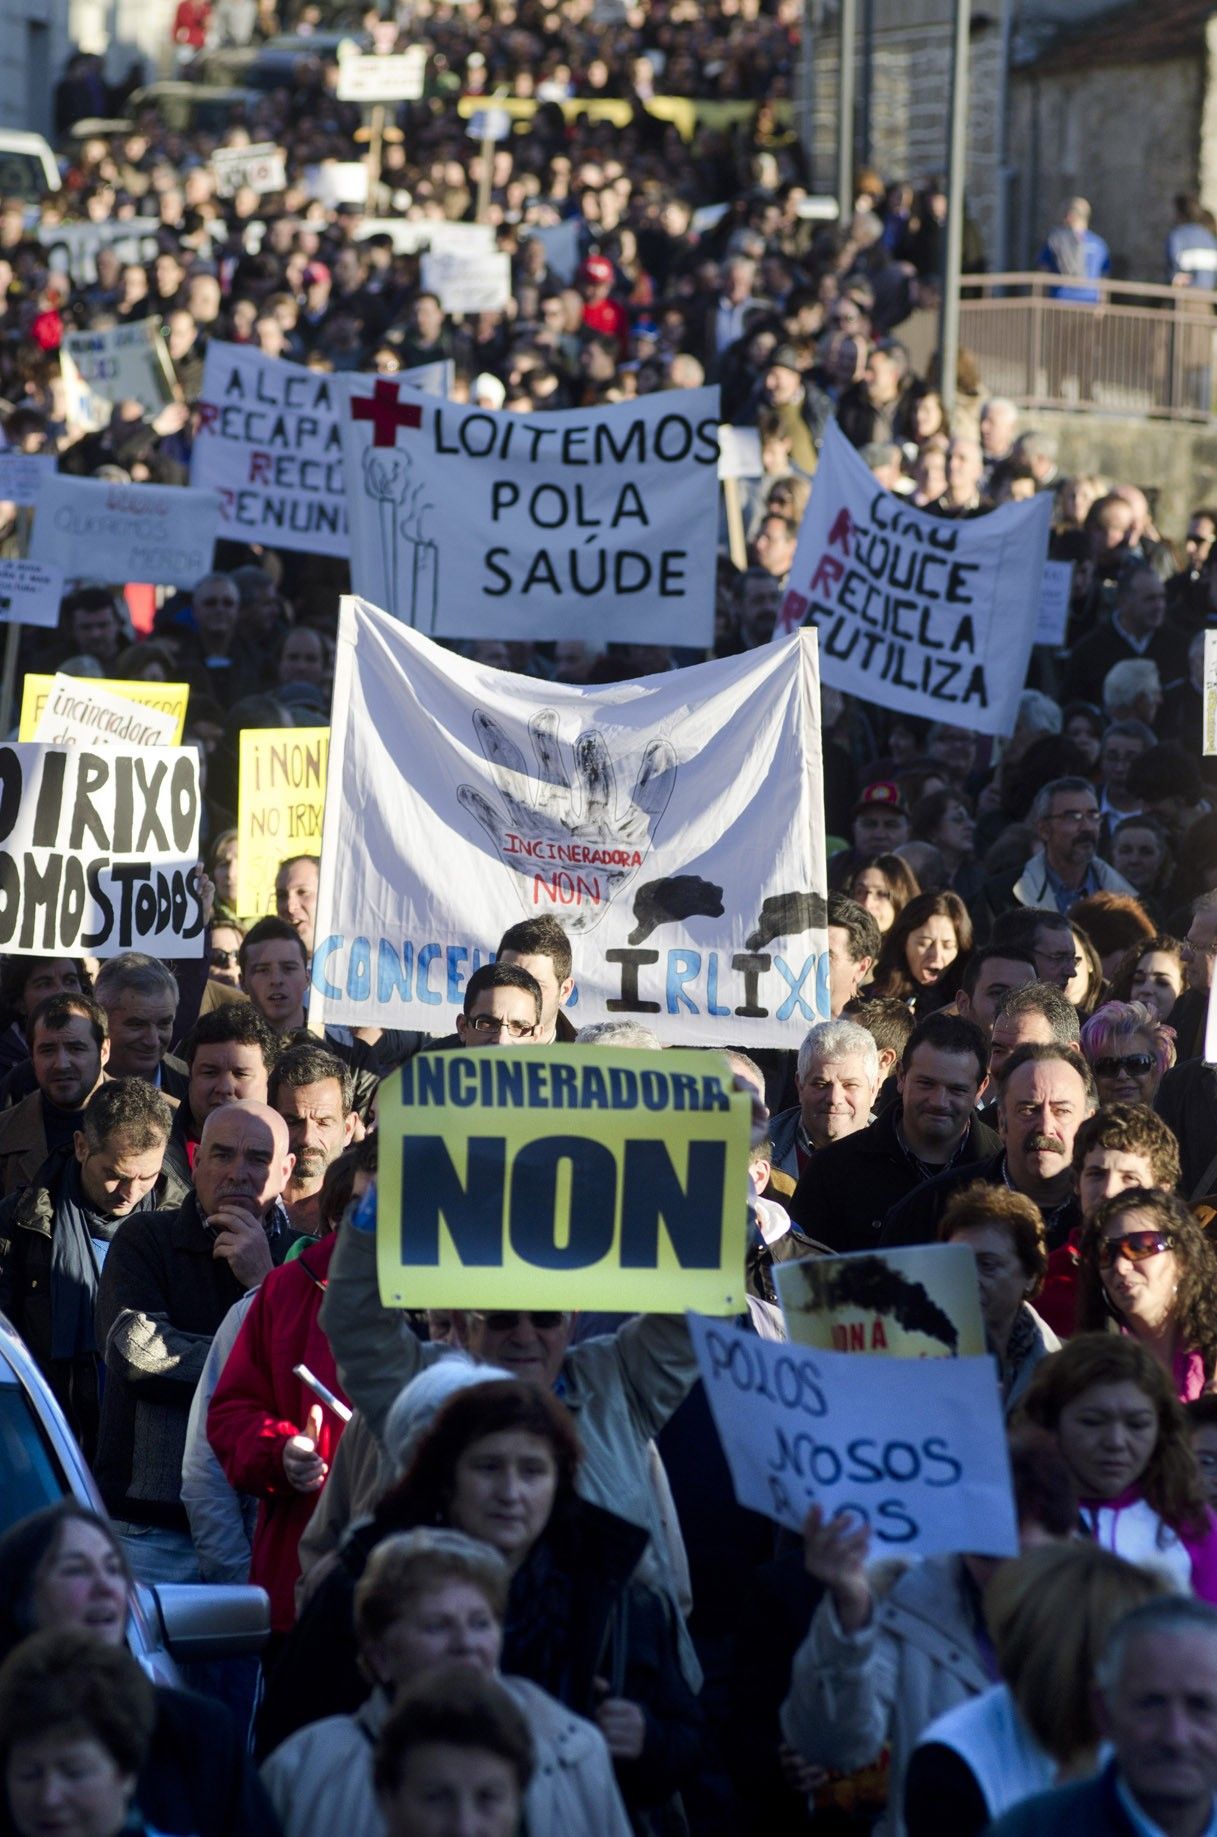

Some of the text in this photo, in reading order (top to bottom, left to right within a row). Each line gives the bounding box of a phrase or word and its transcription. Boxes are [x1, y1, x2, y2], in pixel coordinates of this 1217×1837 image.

[434, 407, 722, 465] LOITEMOS
[491, 480, 650, 529] POLA
[482, 534, 688, 597] SAÚDE
[809, 554, 975, 655] RECICLA
[53, 688, 162, 746] incineradora
[32, 750, 197, 853] IRIXO
[250, 807, 281, 839] NO
[502, 833, 642, 868] INCINERADORA
[110, 861, 204, 948] TODOS
[532, 872, 601, 907] NON
[400, 1055, 731, 1113] INCINERADORA
[400, 1134, 727, 1271] NON
[704, 1328, 829, 1418] POLOS
[767, 1427, 963, 1488] NOSOS
